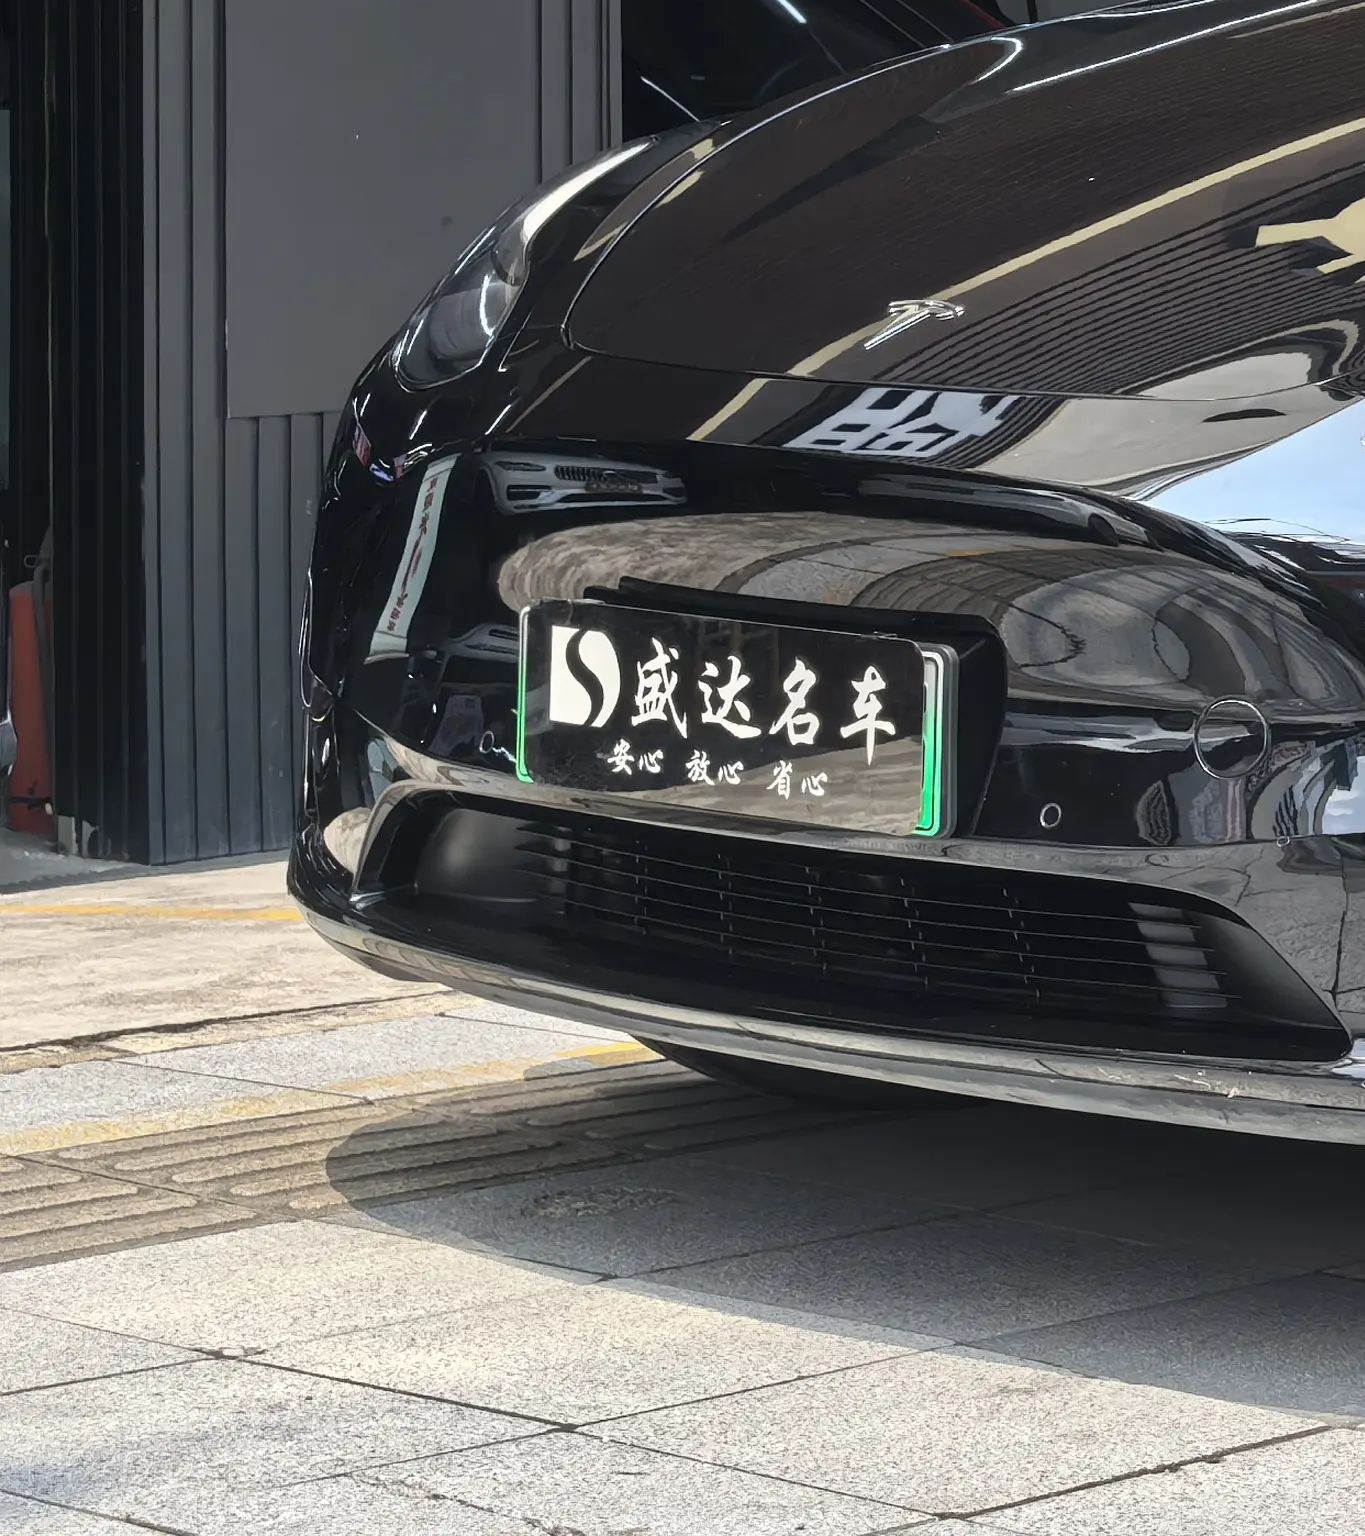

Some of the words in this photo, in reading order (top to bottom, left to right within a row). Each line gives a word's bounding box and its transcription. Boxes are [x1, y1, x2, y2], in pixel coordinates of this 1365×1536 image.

[631, 636, 896, 766] 盛达名车
[606, 740, 664, 776] 安心
[685, 750, 744, 787] 放心
[766, 760, 829, 800] 省心
